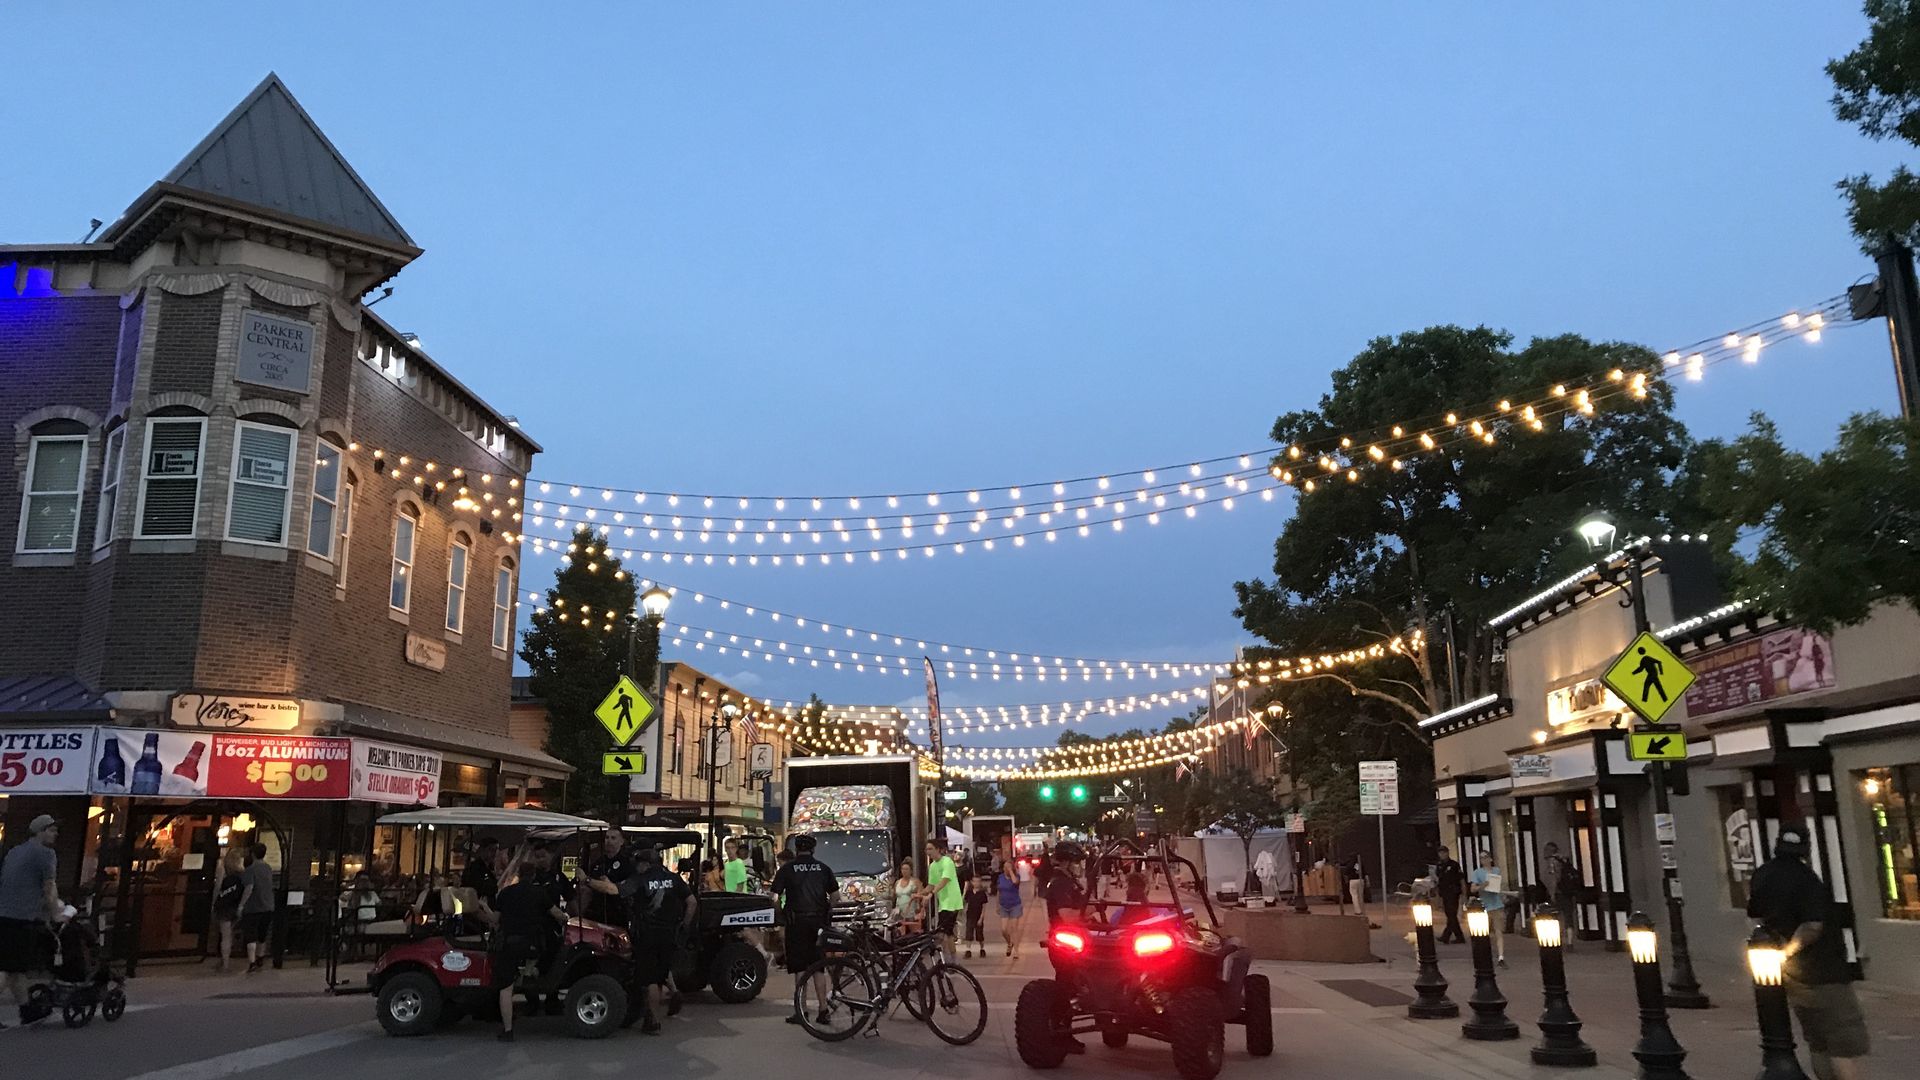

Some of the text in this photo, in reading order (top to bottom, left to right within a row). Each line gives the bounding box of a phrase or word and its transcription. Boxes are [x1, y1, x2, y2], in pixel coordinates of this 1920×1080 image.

[253, 321, 303, 340] PARKER
[247, 332, 306, 353] CENTRAL
[260, 363, 288, 374] CIRCA
[0, 733, 82, 750] TTLES
[216, 744, 256, 757] 16oz
[368, 746, 391, 767] WELCOME
[391, 750, 398, 767] TO
[398, 751, 415, 769] PARKER
[368, 772, 389, 792] STELLA
[389, 775, 413, 795] DRAUGHT
[648, 879, 673, 890] POLICE
[729, 915, 771, 923] POLICE
